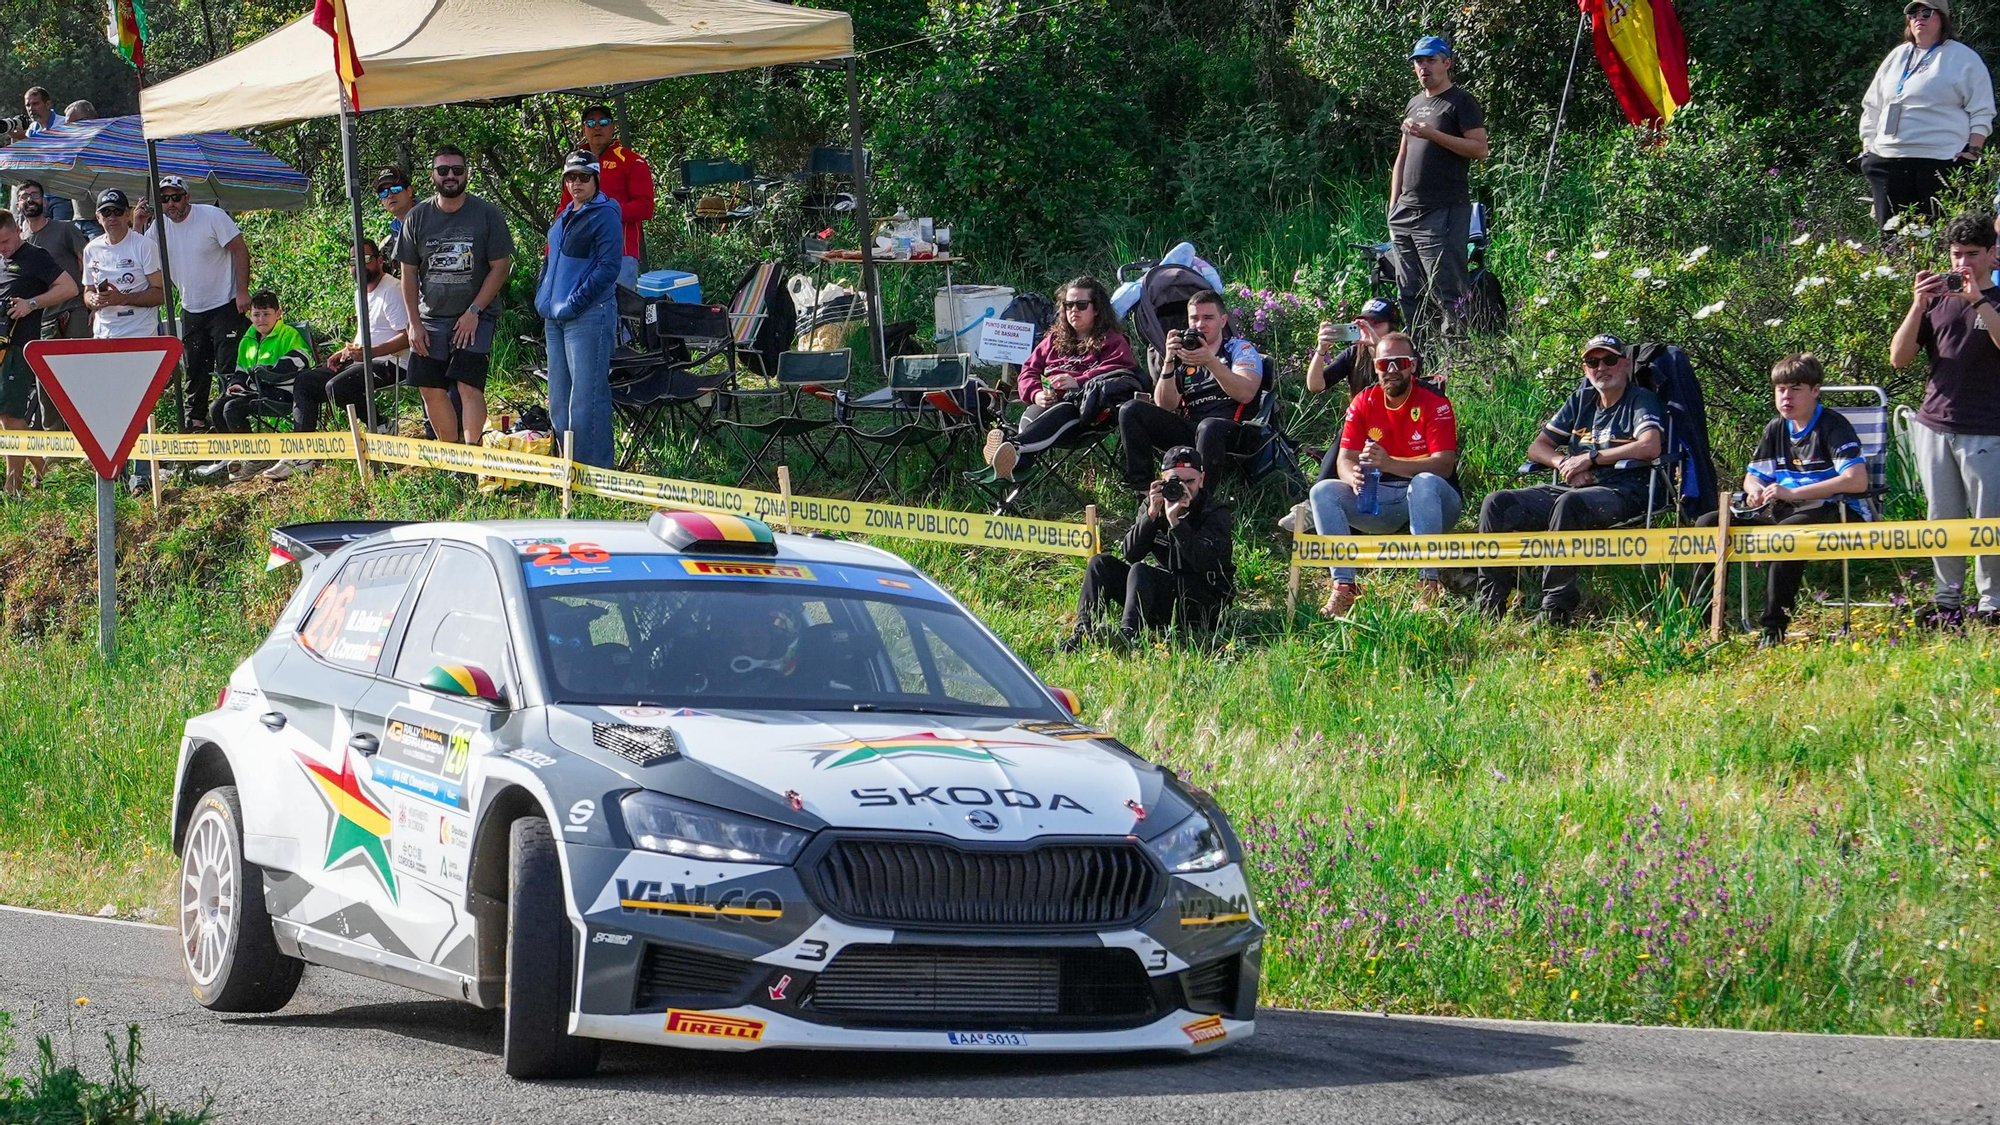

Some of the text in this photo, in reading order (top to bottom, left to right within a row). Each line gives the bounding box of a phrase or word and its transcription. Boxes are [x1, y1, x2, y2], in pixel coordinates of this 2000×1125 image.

[0, 436, 20, 450] BLICO
[27, 436, 75, 452] ZONA PUBLICO
[139, 439, 198, 455] ZONA PUBLICO
[207, 439, 271, 455] ZONA PUBLICO
[280, 437, 346, 454] ZONA PUBLICO
[361, 438, 410, 460] ONA PUBLICO
[418, 444, 475, 468] ZONA PUBLICO
[482, 453, 542, 477] ZONA PUBLICO
[567, 466, 645, 497] ONA PUBLICO
[656, 482, 742, 512] ZONA PUBLICO
[754, 496, 851, 525] ZONA PUBLICO
[865, 508, 970, 537] ZONA PUBLICO
[984, 520, 1093, 550] ZONA PUBLICO
[1668, 533, 1796, 556] ZONA PUBLICO
[1816, 528, 1948, 552] ZONA PUBLICO
[525, 542, 611, 567] 26
[1292, 540, 1359, 562] PUBLICO
[1377, 540, 1500, 562] ZONA PUBLICO
[1520, 536, 1648, 560] ZONA PUBLICO
[693, 562, 803, 578] PIRELLI
[300, 583, 356, 653] 26
[403, 723, 421, 738] RALLY
[444, 728, 473, 775] 26
[850, 786, 1094, 815] SKODA
[667, 1012, 763, 1038] PIRELLI
[960, 1034, 1020, 1044] AA S013
